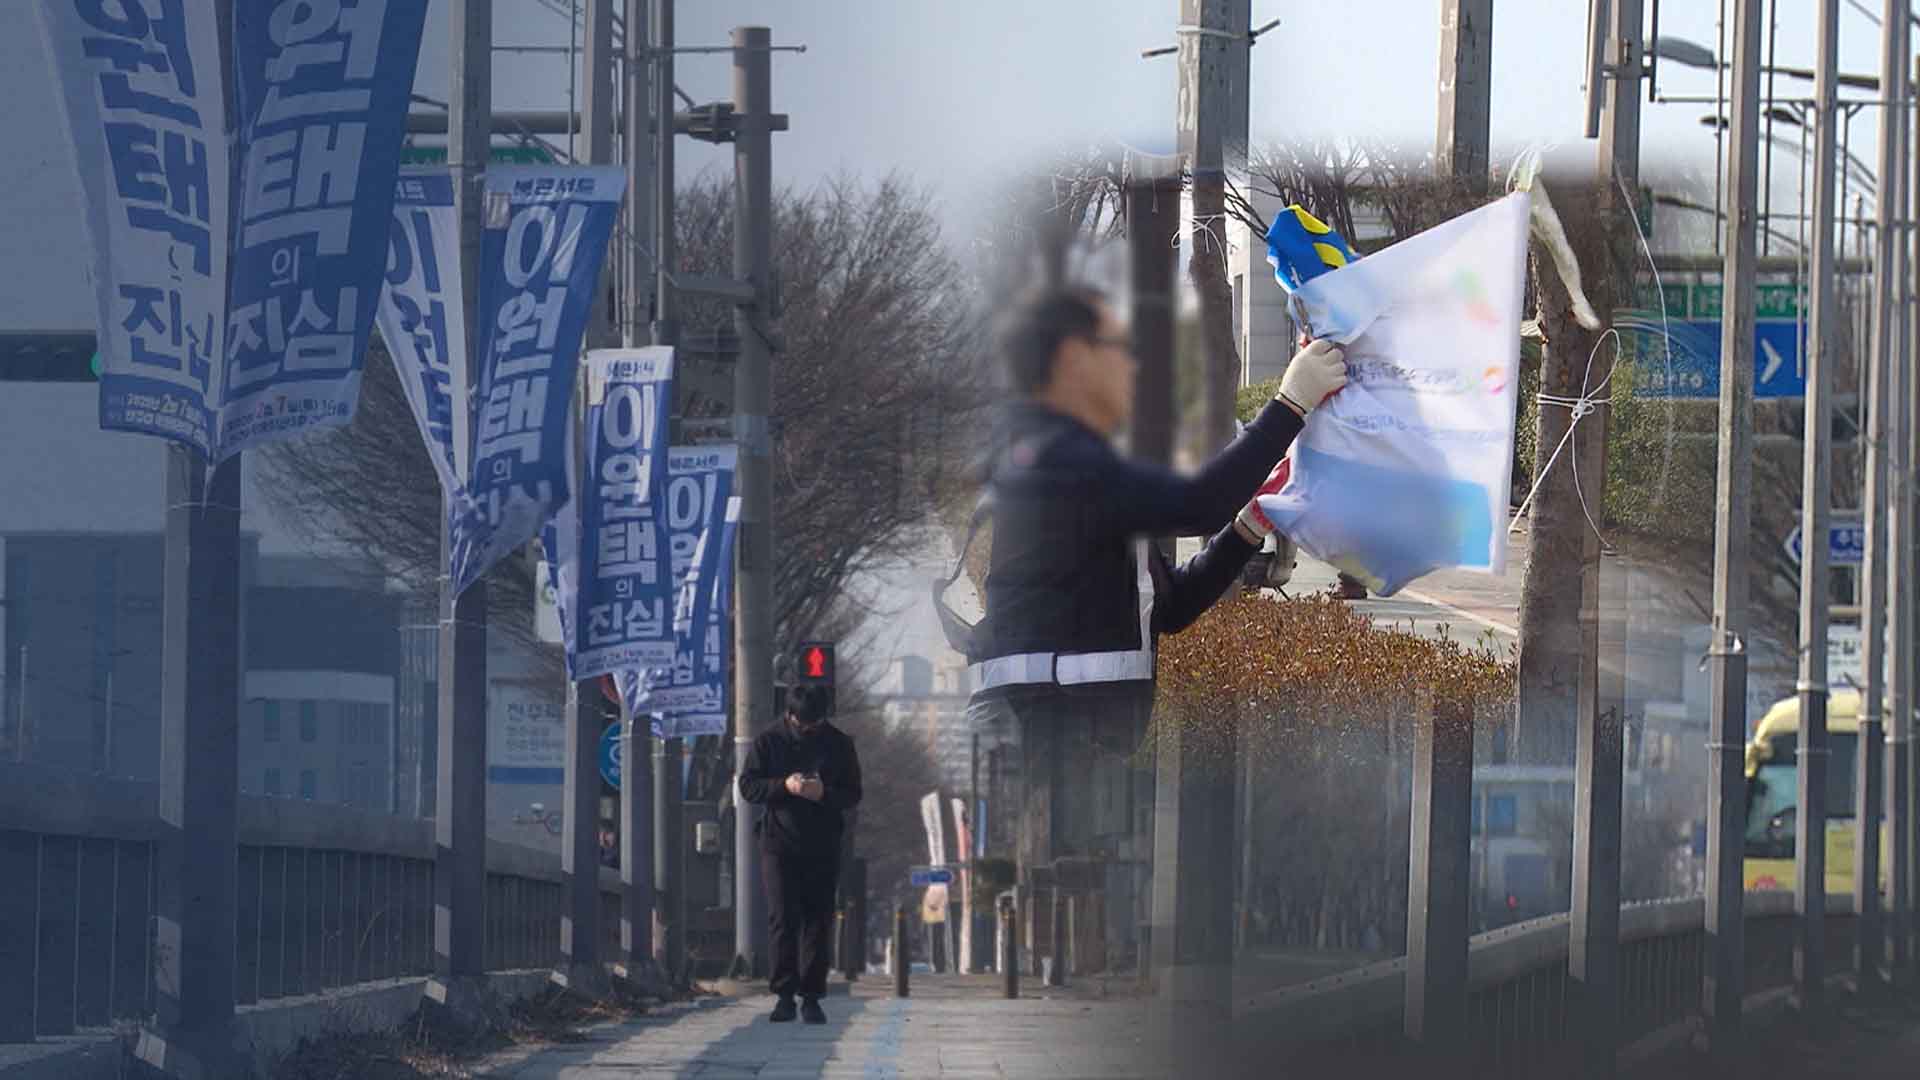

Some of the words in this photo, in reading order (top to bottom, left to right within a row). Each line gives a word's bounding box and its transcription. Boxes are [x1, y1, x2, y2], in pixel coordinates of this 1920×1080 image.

[270, 245, 300, 287] 의
[228, 286, 357, 390] 진심
[597, 383, 657, 585] 이원택
[616, 577, 633, 598] 의
[588, 597, 665, 646] 진심
